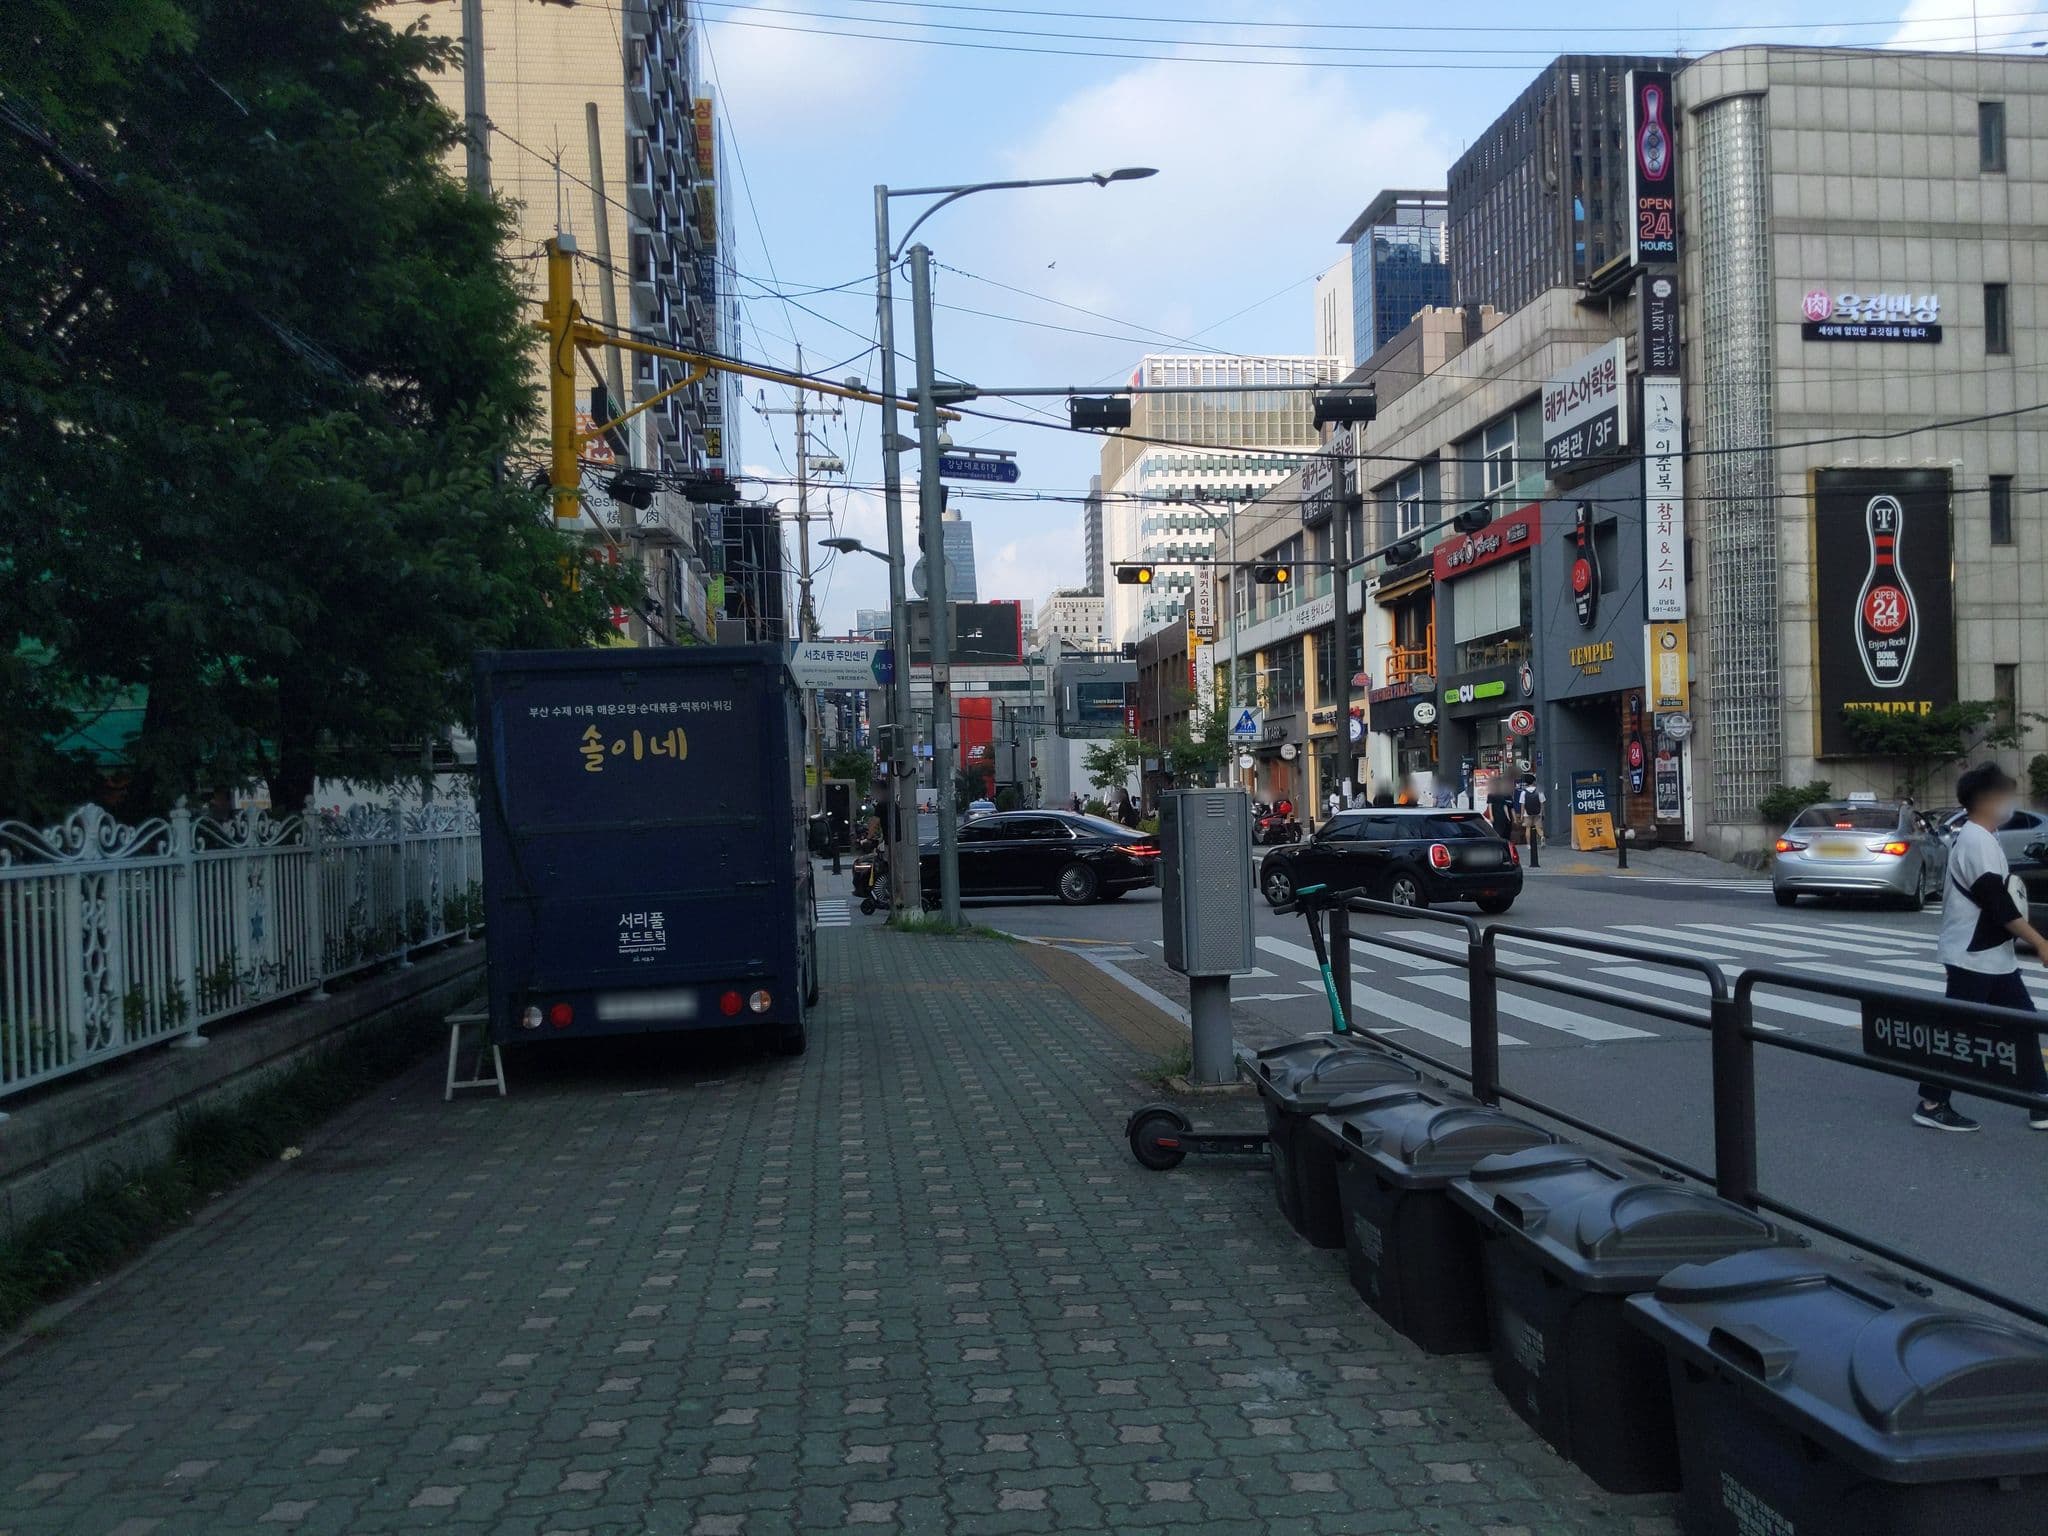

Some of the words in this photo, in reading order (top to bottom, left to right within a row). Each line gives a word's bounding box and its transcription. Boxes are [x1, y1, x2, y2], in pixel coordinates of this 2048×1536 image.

[1640, 198, 1672, 209] OPEN
[1640, 212, 1672, 239] 24
[1640, 241, 1673, 251] HOURS
[1807, 295, 1827, 317] 肉
[1834, 294, 1940, 323] 육집반상
[1652, 301, 1664, 331] TARR
[1818, 326, 1842, 337] 세상에
[1869, 326, 1900, 338] 고깃집을
[1903, 327, 1929, 338] 만들다.
[1653, 337, 1665, 367] TARR
[1545, 357, 1616, 422] 해커스어학원
[1551, 431, 1583, 469] 2별관
[1595, 417, 1613, 447] 3F
[948, 460, 997, 473] 강남대로61길
[1657, 503, 1673, 537] 참치
[1660, 542, 1671, 554] &
[1576, 571, 1585, 583] 24
[1658, 559, 1674, 592] 스시
[1200, 571, 1210, 625] 해커스어학원
[1874, 590, 1897, 600] OPEN
[1873, 599, 1899, 619] 24
[1874, 618, 1899, 629] HOURS
[1569, 641, 1614, 667] TEMPLE
[1868, 640, 1887, 651] Enjoy
[1460, 684, 1474, 703] CU
[529, 706, 549, 718] 부산
[552, 705, 572, 717] 수제
[574, 705, 594, 716] 어묵
[579, 724, 688, 772] 솔이네
[1631, 748, 1640, 759] 24
[1577, 788, 1605, 800] 해커스
[1578, 799, 1606, 811] 어학원
[1588, 827, 1604, 838] 3F
[618, 912, 665, 929] 서리풀
[619, 930, 666, 944] 푸드트럭
[1875, 1017, 2017, 1075] 어린이보호구역
